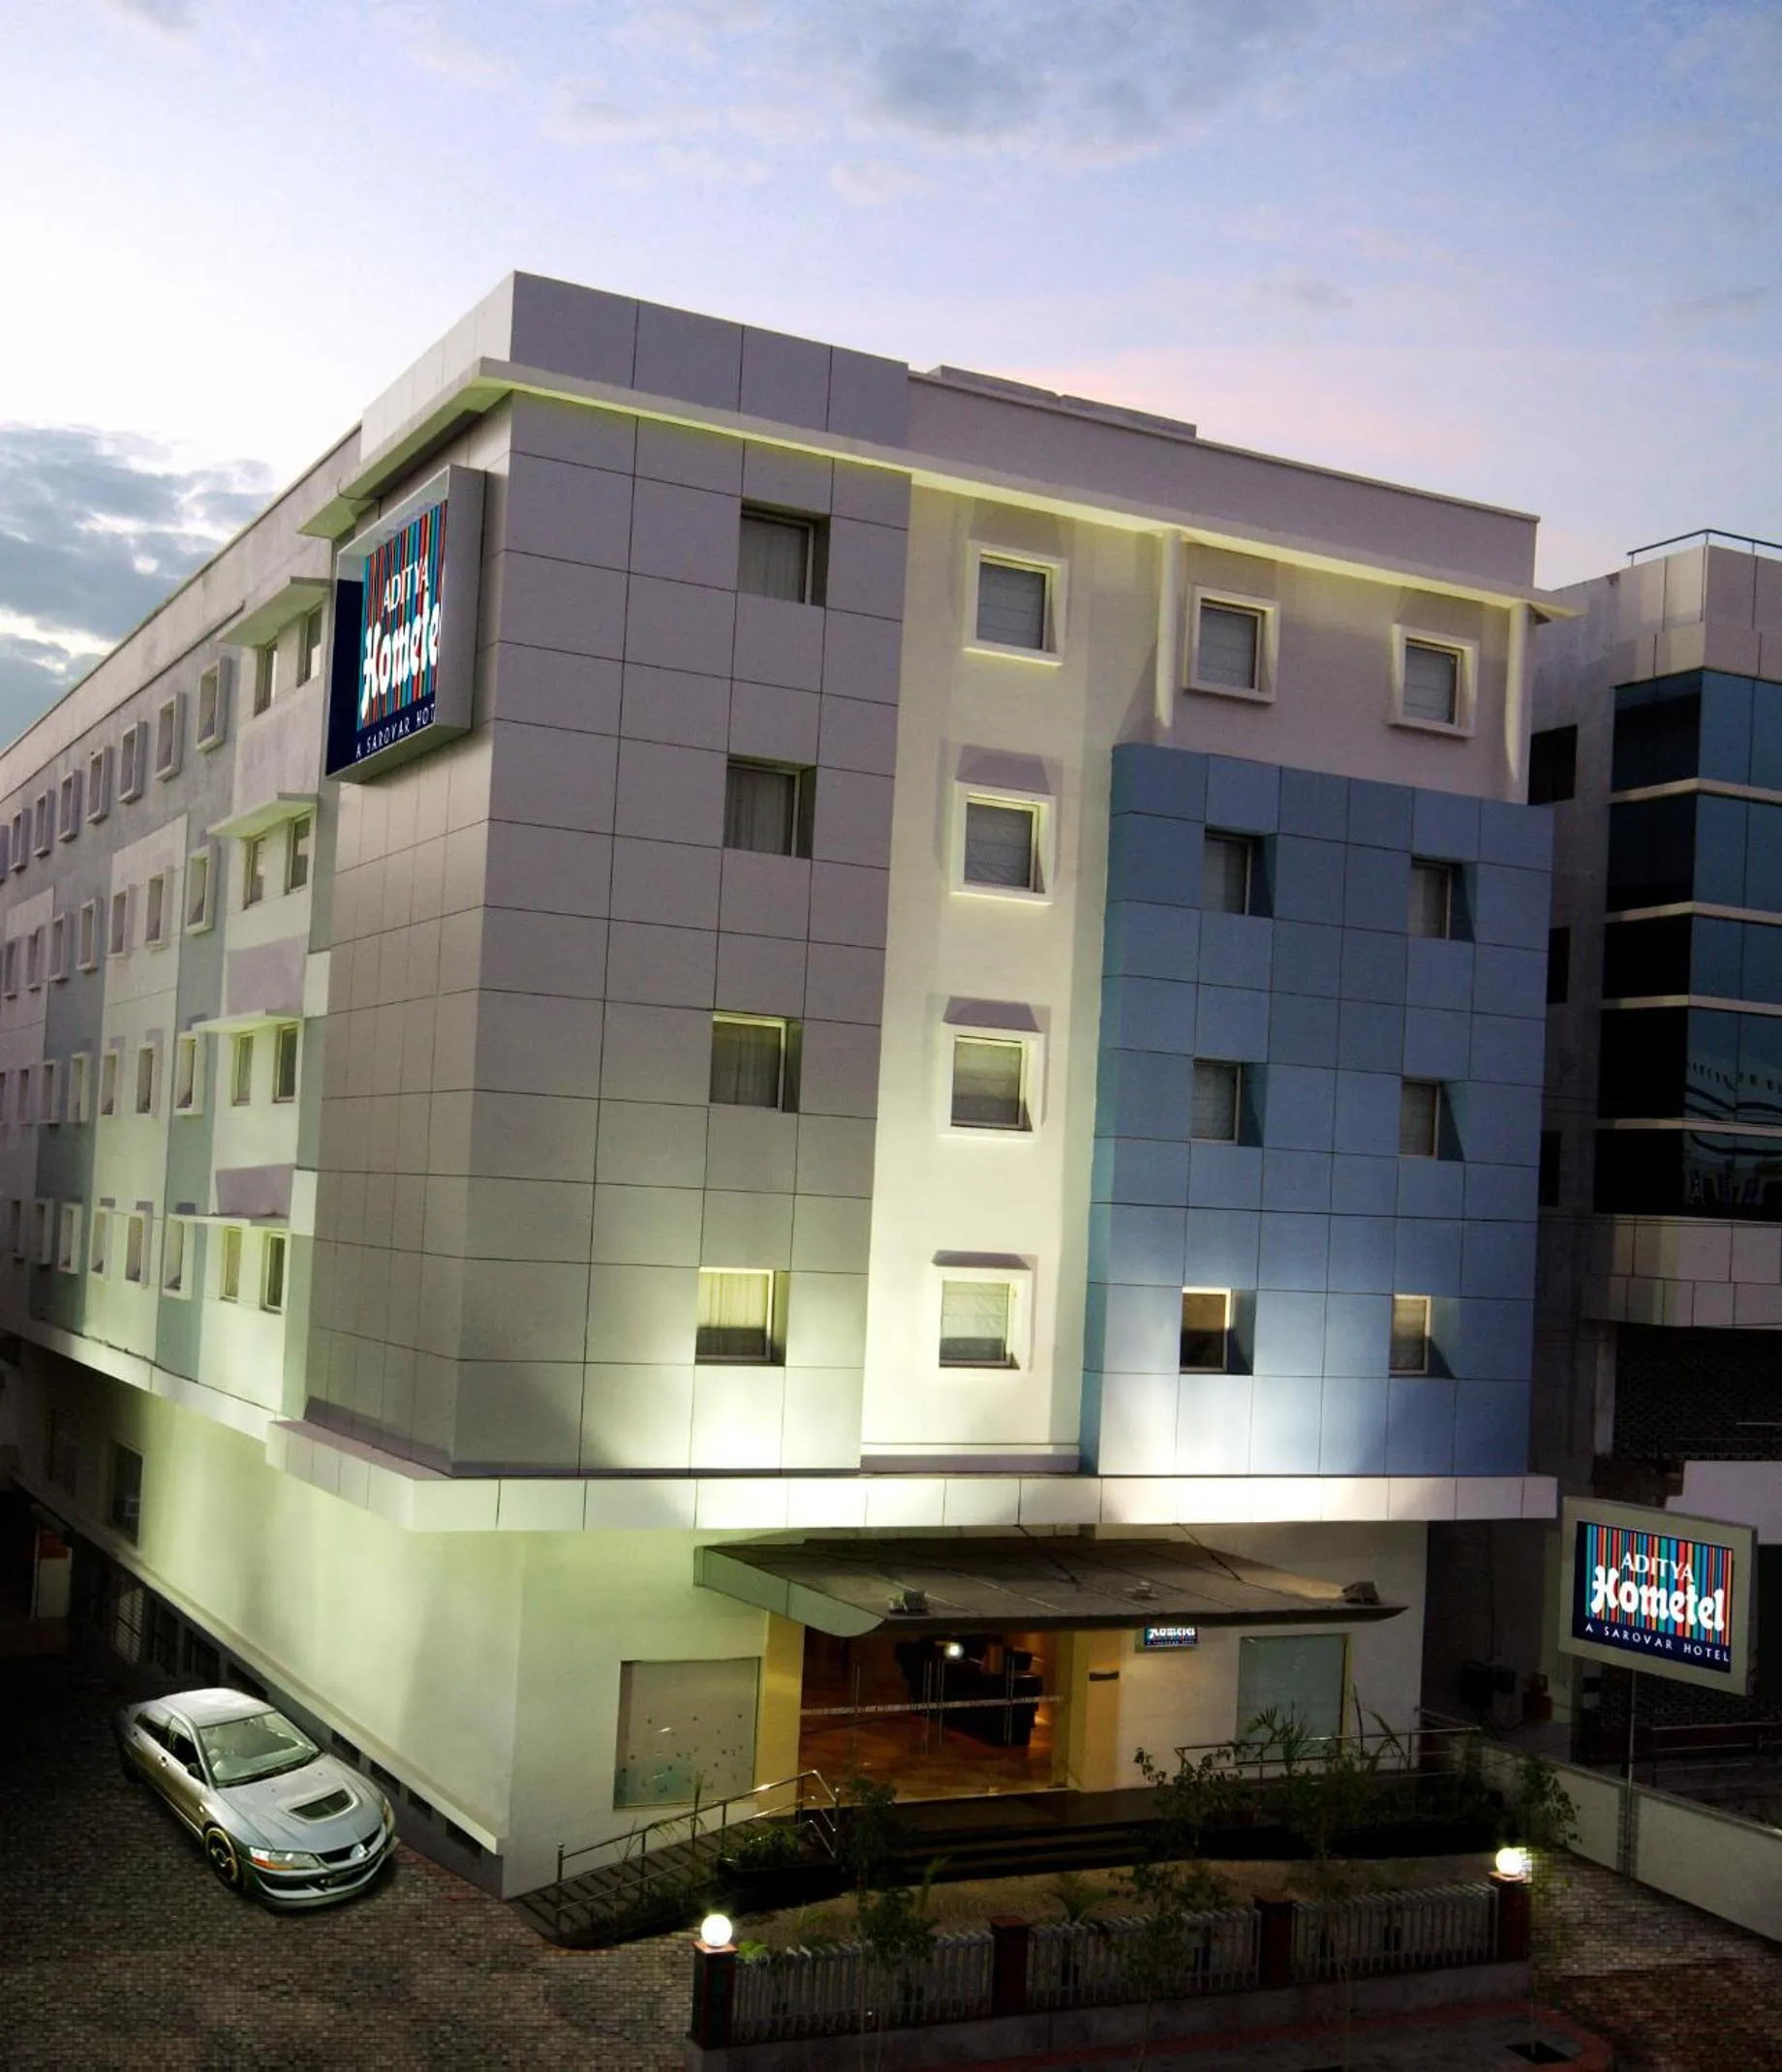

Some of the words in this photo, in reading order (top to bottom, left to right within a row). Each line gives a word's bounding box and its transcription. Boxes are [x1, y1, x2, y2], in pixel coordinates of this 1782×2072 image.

[381, 554, 429, 617] ADITYA
[360, 592, 442, 719] Homete
[355, 742, 362, 759] A
[366, 716, 410, 753] SAROVAR
[415, 703, 435, 728] HOT
[1620, 1551, 1695, 1583] ADITYA
[1590, 1565, 1725, 1631] Hometel
[1584, 1623, 1594, 1633] A
[1604, 1626, 1673, 1650] SAROVAR
[1683, 1642, 1730, 1662] HOTEL
